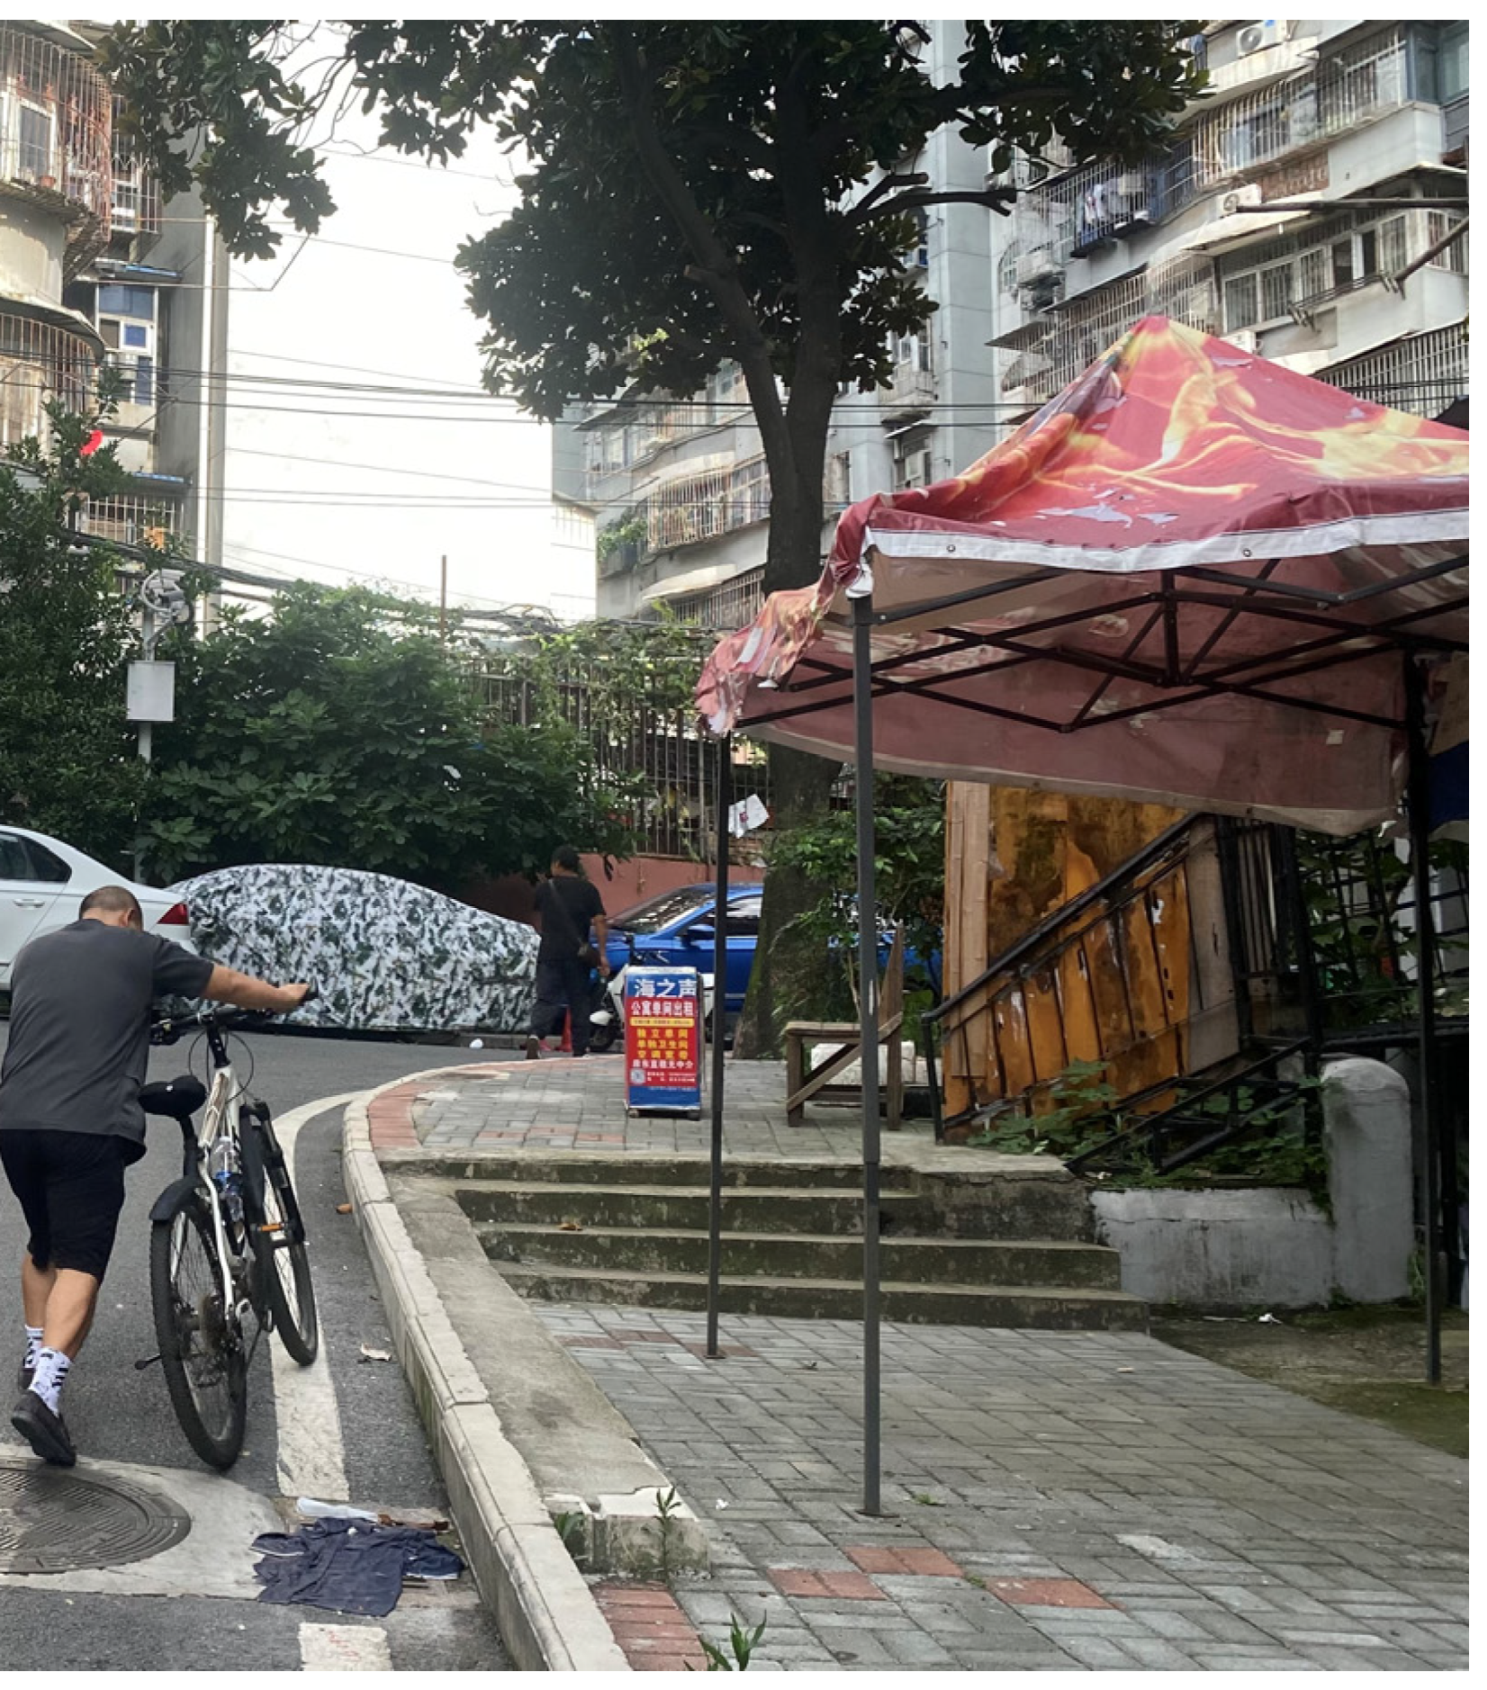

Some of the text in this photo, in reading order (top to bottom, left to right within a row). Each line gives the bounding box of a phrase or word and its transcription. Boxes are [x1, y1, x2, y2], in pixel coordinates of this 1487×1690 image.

[634, 978, 697, 998] 海之声
[631, 1001, 694, 1017] 公寓单间出租
